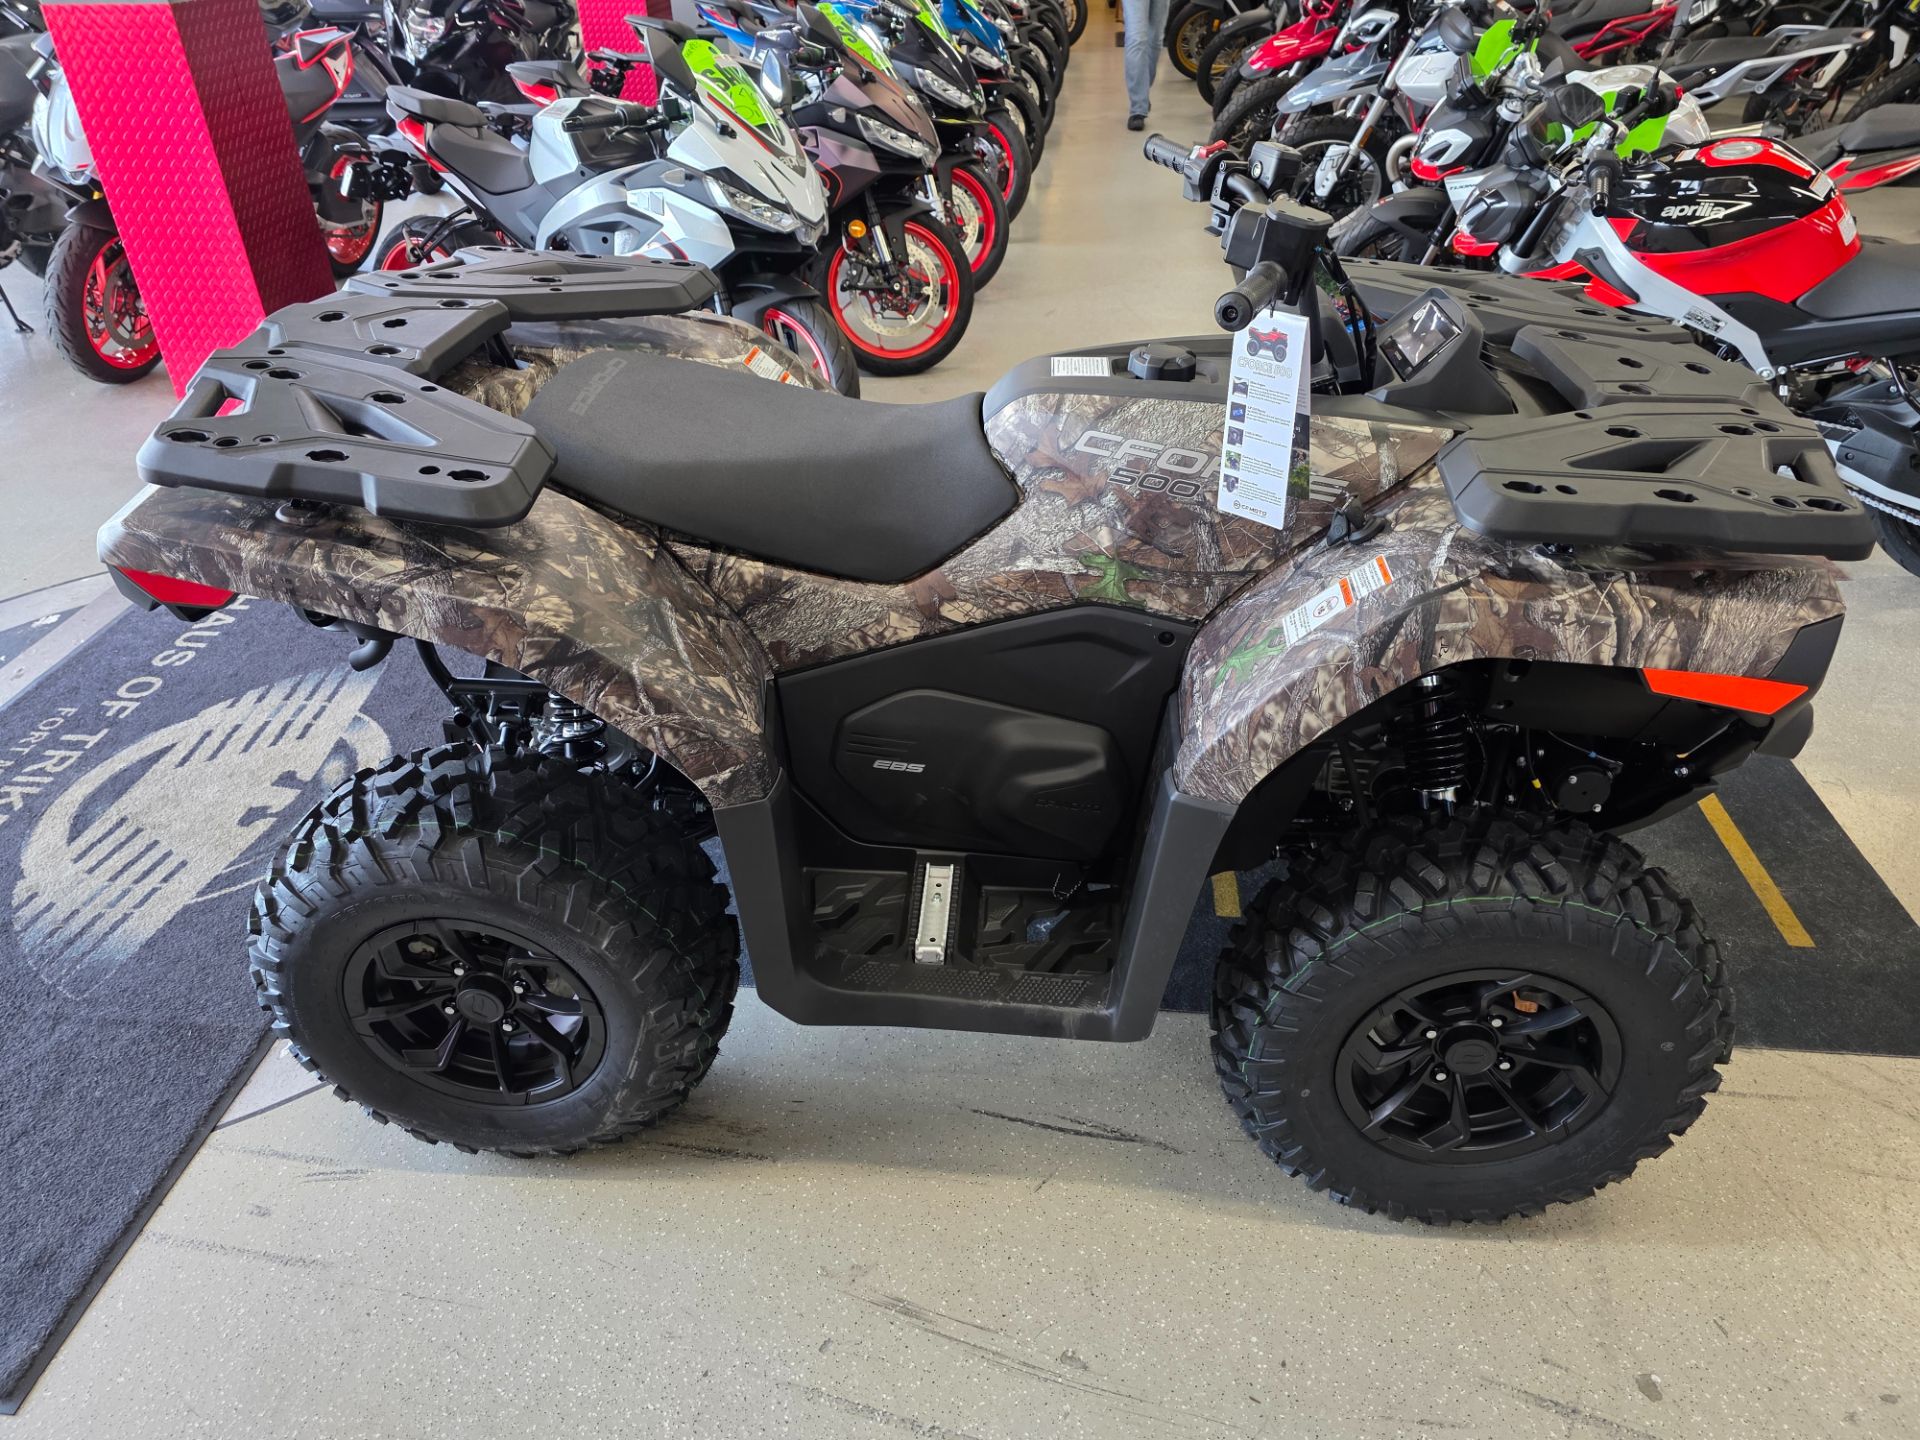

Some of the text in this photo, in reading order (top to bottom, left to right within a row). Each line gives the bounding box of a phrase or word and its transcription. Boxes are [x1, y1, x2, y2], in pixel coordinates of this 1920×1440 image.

[1660, 202, 1725, 219] aprilia
[567, 357, 628, 417] CFORCE
[1074, 430, 1351, 503] CFOE
[1107, 466, 1201, 499] 500
[100, 676, 163, 719] OF
[9, 706, 79, 756] FORT
[0, 728, 110, 825] TRIK
[872, 759, 926, 773] EBS
